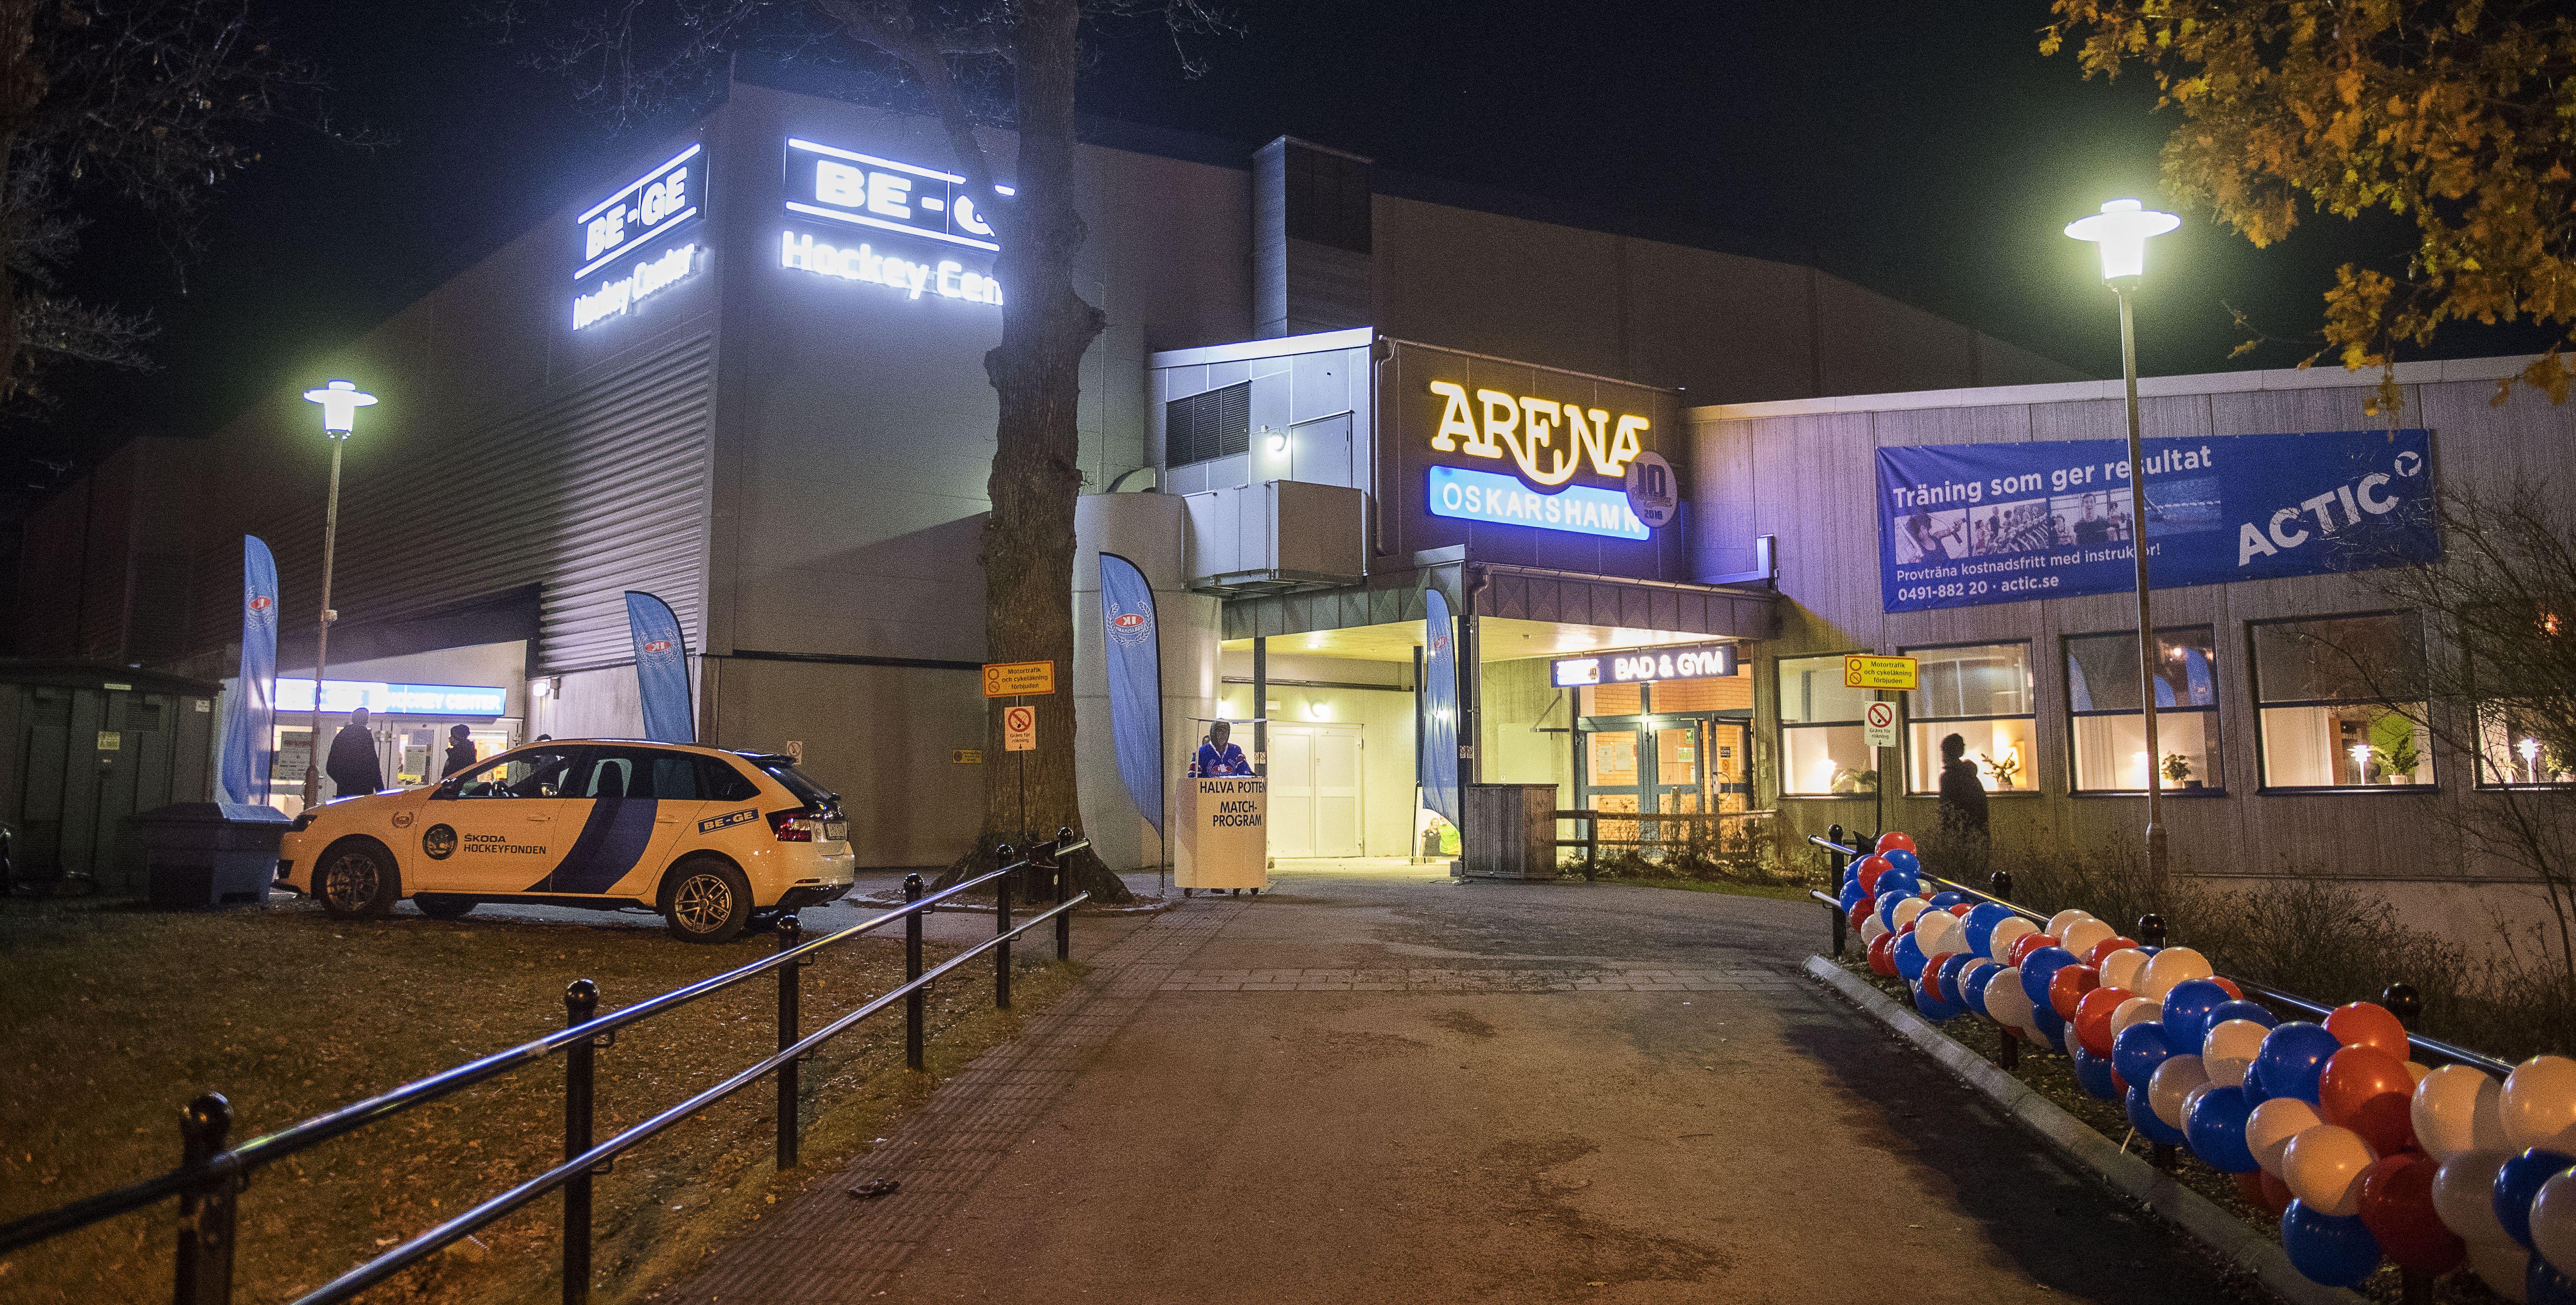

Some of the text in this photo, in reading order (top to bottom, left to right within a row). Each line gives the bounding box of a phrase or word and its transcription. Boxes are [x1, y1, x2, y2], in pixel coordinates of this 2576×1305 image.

[782, 230, 929, 299] Hockey
[573, 243, 695, 331] Hockey Center
[1430, 380, 1650, 486] ARENA
[1635, 462, 1666, 497] 10
[1893, 445, 2212, 508] Träning som ger reultat
[1443, 482, 1640, 534] OSKARSHAMN
[2239, 472, 2399, 567] ACTIC
[1897, 543, 2160, 582] Provträna kostnadsfritt med instrukr!
[1898, 575, 2059, 601] 0491-882 20 actic.se
[1615, 656, 1655, 680] BAD
[1659, 655, 1674, 677] &
[1677, 651, 1724, 675] GYM
[446, 693, 501, 711] CENTER
[1200, 781, 1267, 793] HALVA POTTEN
[1213, 815, 1262, 826] PROGRAM
[1220, 801, 1257, 813] MATCH-
[464, 833, 506, 843] ŠKODA
[464, 844, 547, 854] HOCKEYFONDEN
